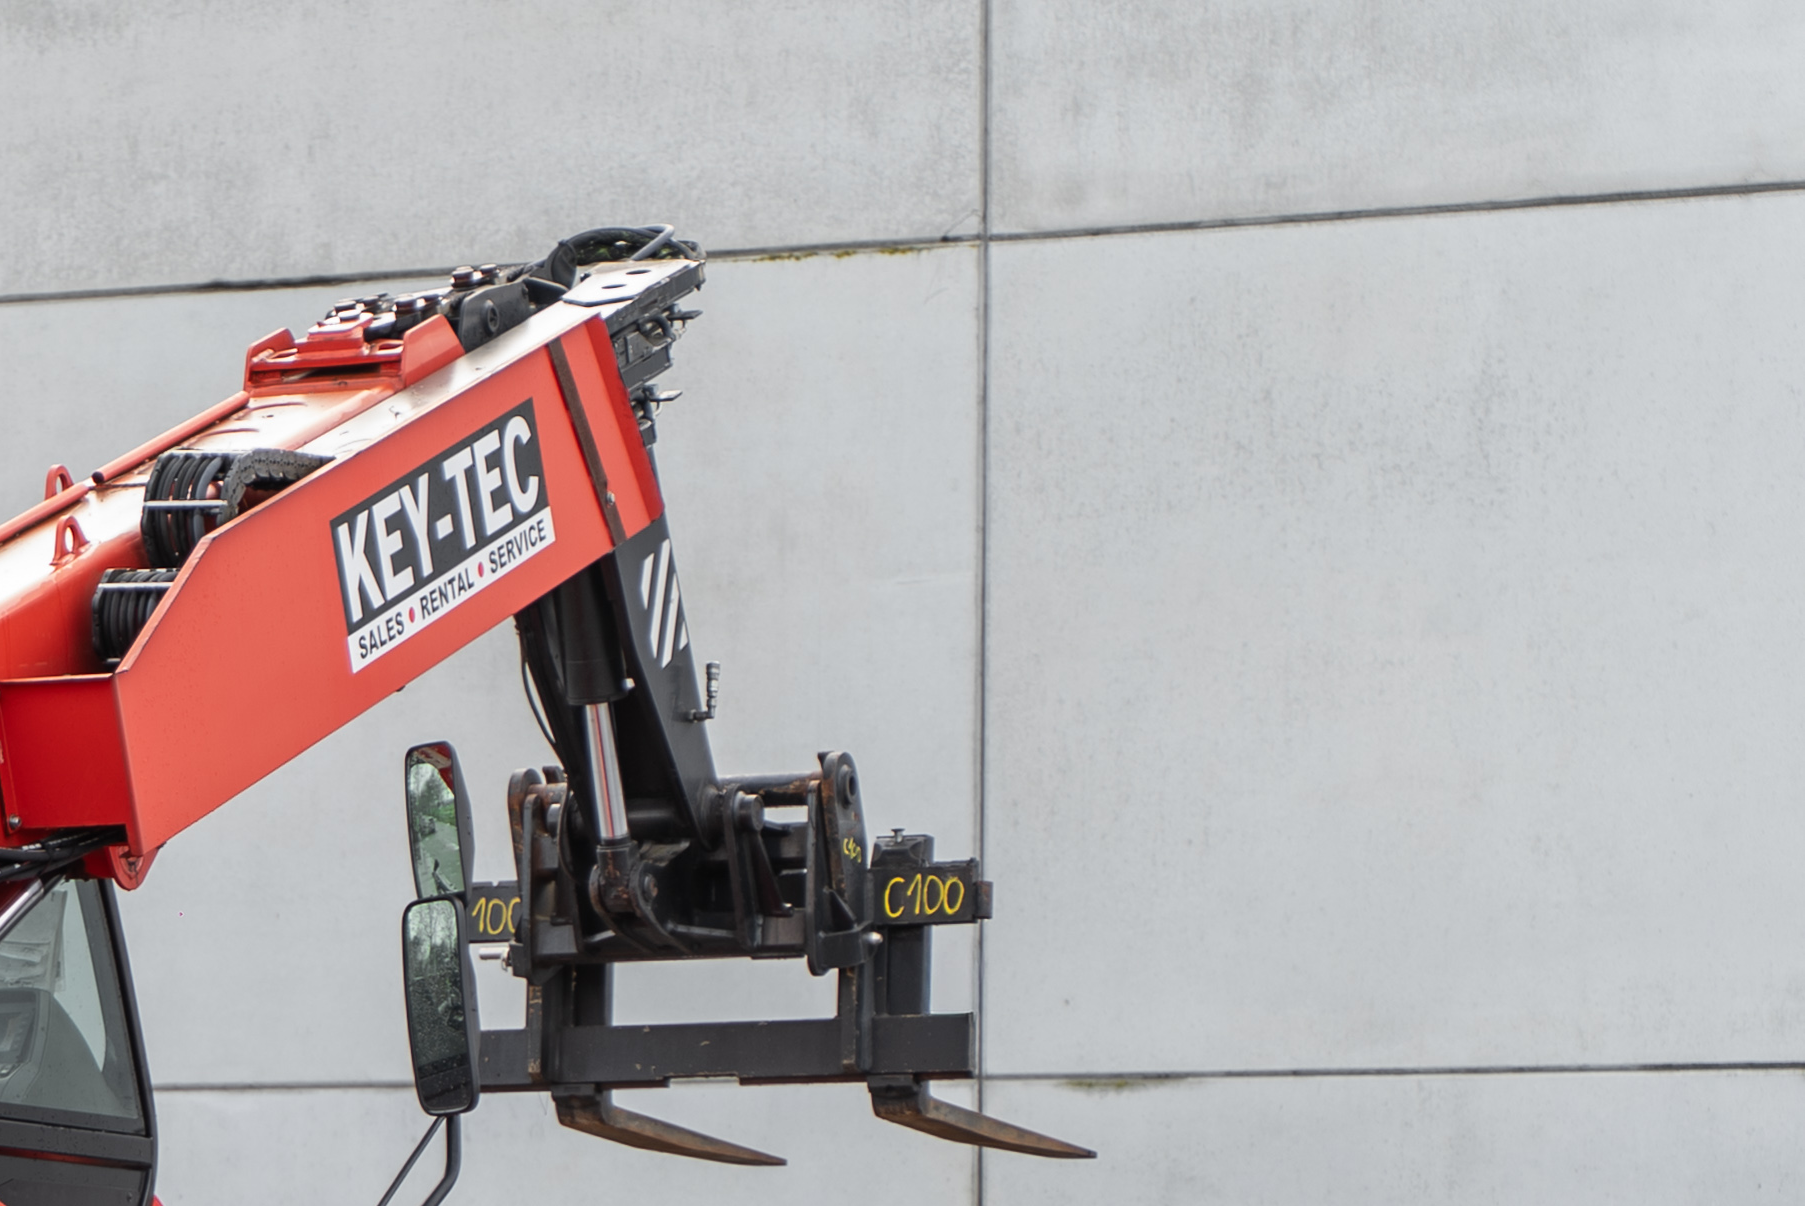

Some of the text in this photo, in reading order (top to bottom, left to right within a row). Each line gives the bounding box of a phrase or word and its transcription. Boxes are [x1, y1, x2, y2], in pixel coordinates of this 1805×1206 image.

[336, 414, 540, 624] KEY-TEC
[358, 518, 547, 660] SALES RENTAL SERVICE
[884, 873, 965, 918] C100
